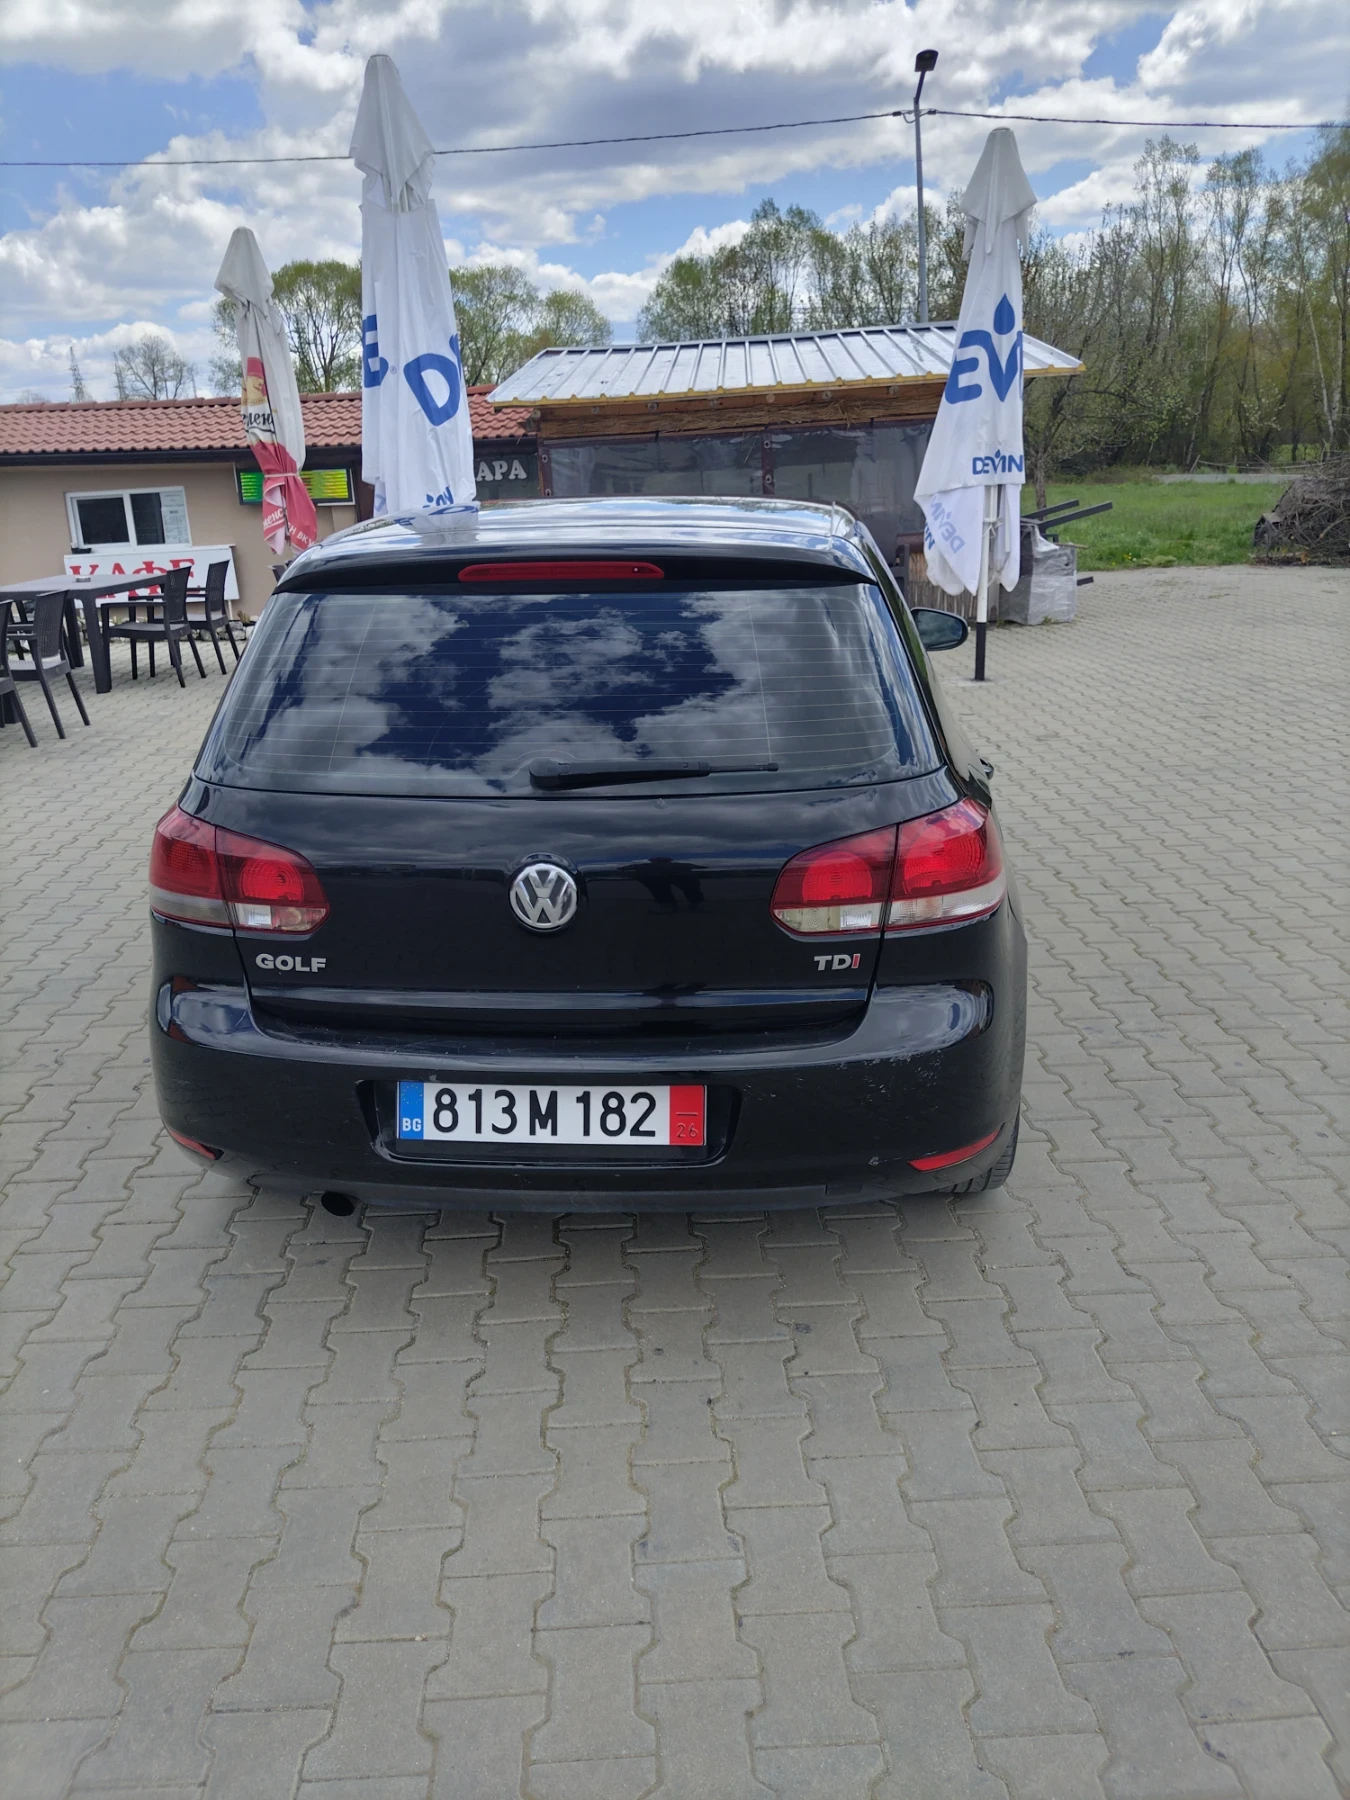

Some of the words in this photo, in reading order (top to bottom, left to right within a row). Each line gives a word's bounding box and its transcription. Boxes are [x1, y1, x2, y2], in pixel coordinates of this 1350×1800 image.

[972, 453, 1024, 475] DEVIN
[69, 558, 196, 598] АФ
[510, 863, 578, 927] VW
[255, 953, 327, 973] GOLF
[813, 953, 861, 971] TDI
[402, 1117, 422, 1132] BG
[676, 1122, 698, 1138] 26
